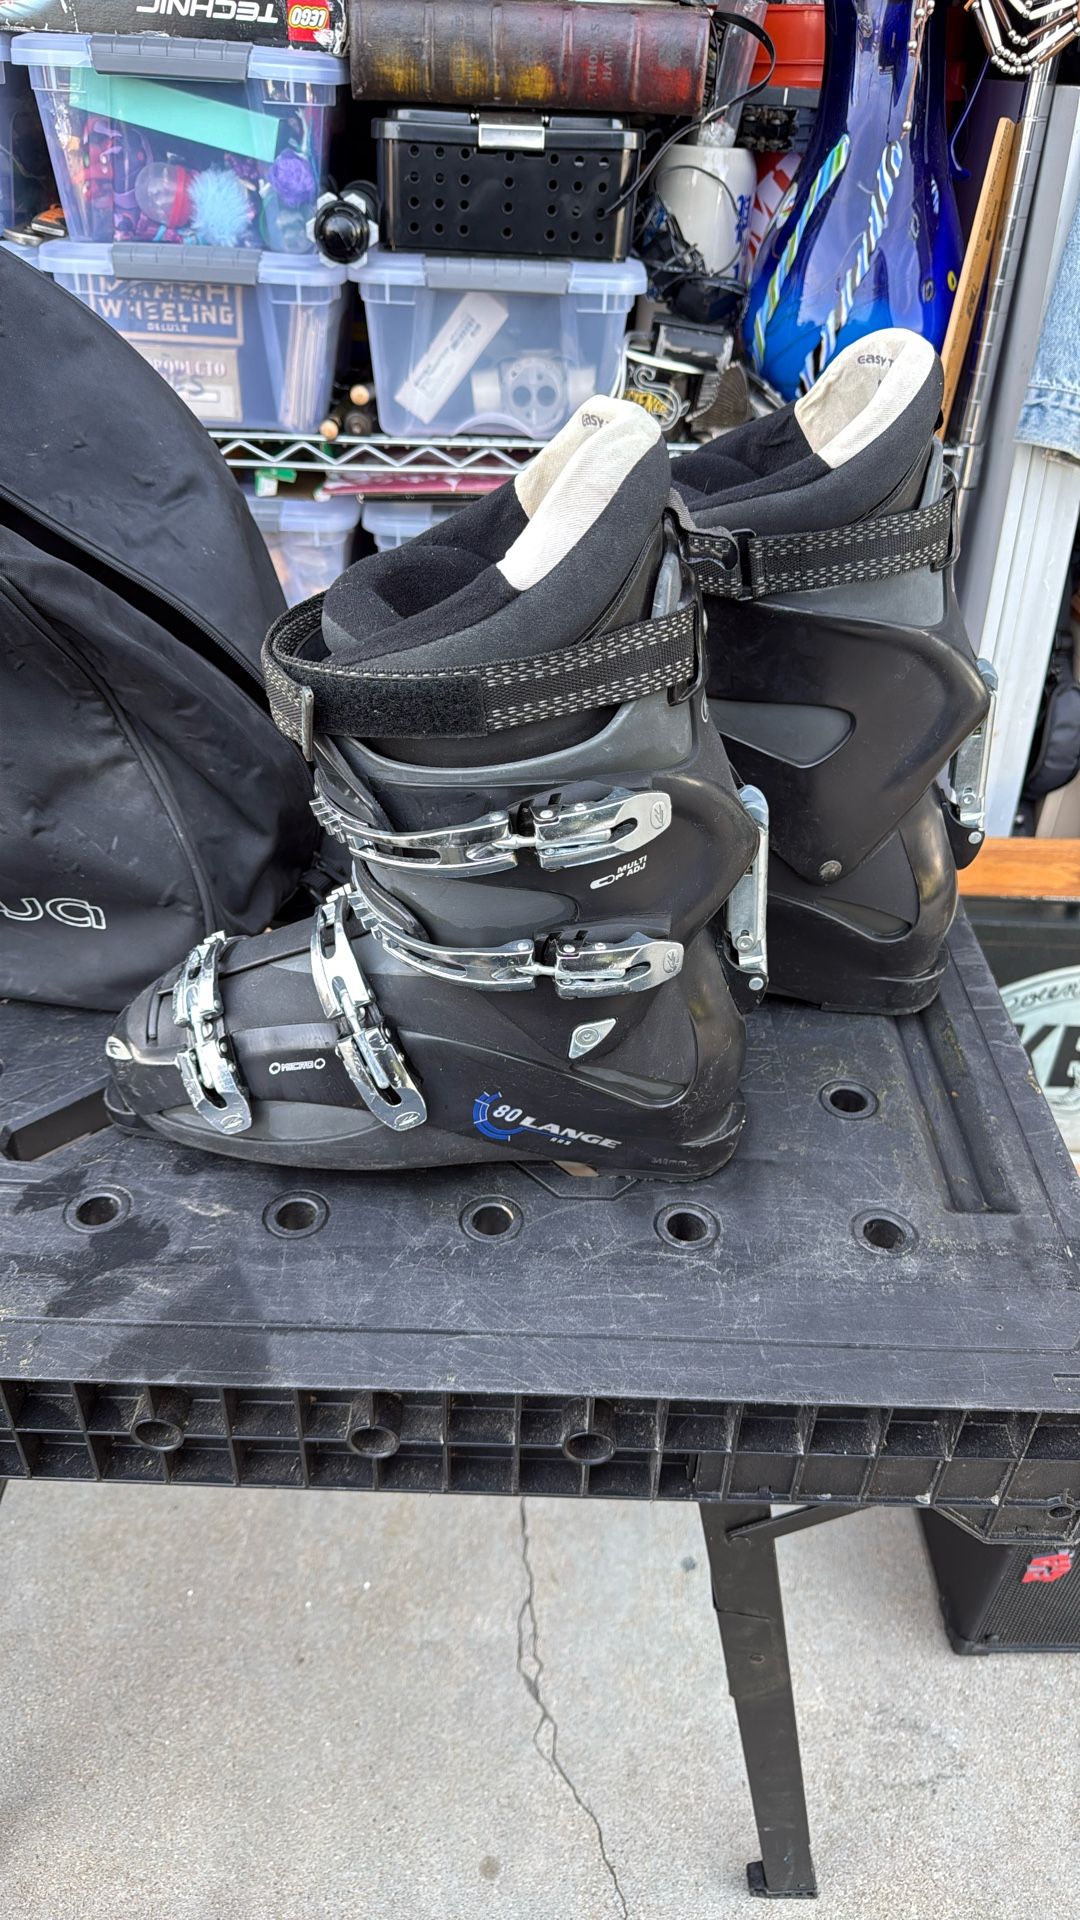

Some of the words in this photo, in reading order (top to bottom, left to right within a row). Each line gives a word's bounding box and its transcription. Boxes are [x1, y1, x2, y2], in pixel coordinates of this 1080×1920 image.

[136, 0, 279, 24] TECHNIC
[290, 7, 328, 28] LEGO
[586, 24, 601, 87] THOMS
[99, 297, 235, 326] WHEELING
[617, 854, 648, 873] MULTI
[626, 862, 646, 877] ADJ
[492, 1104, 523, 1122] 80
[518, 1115, 622, 1149] LANGE
